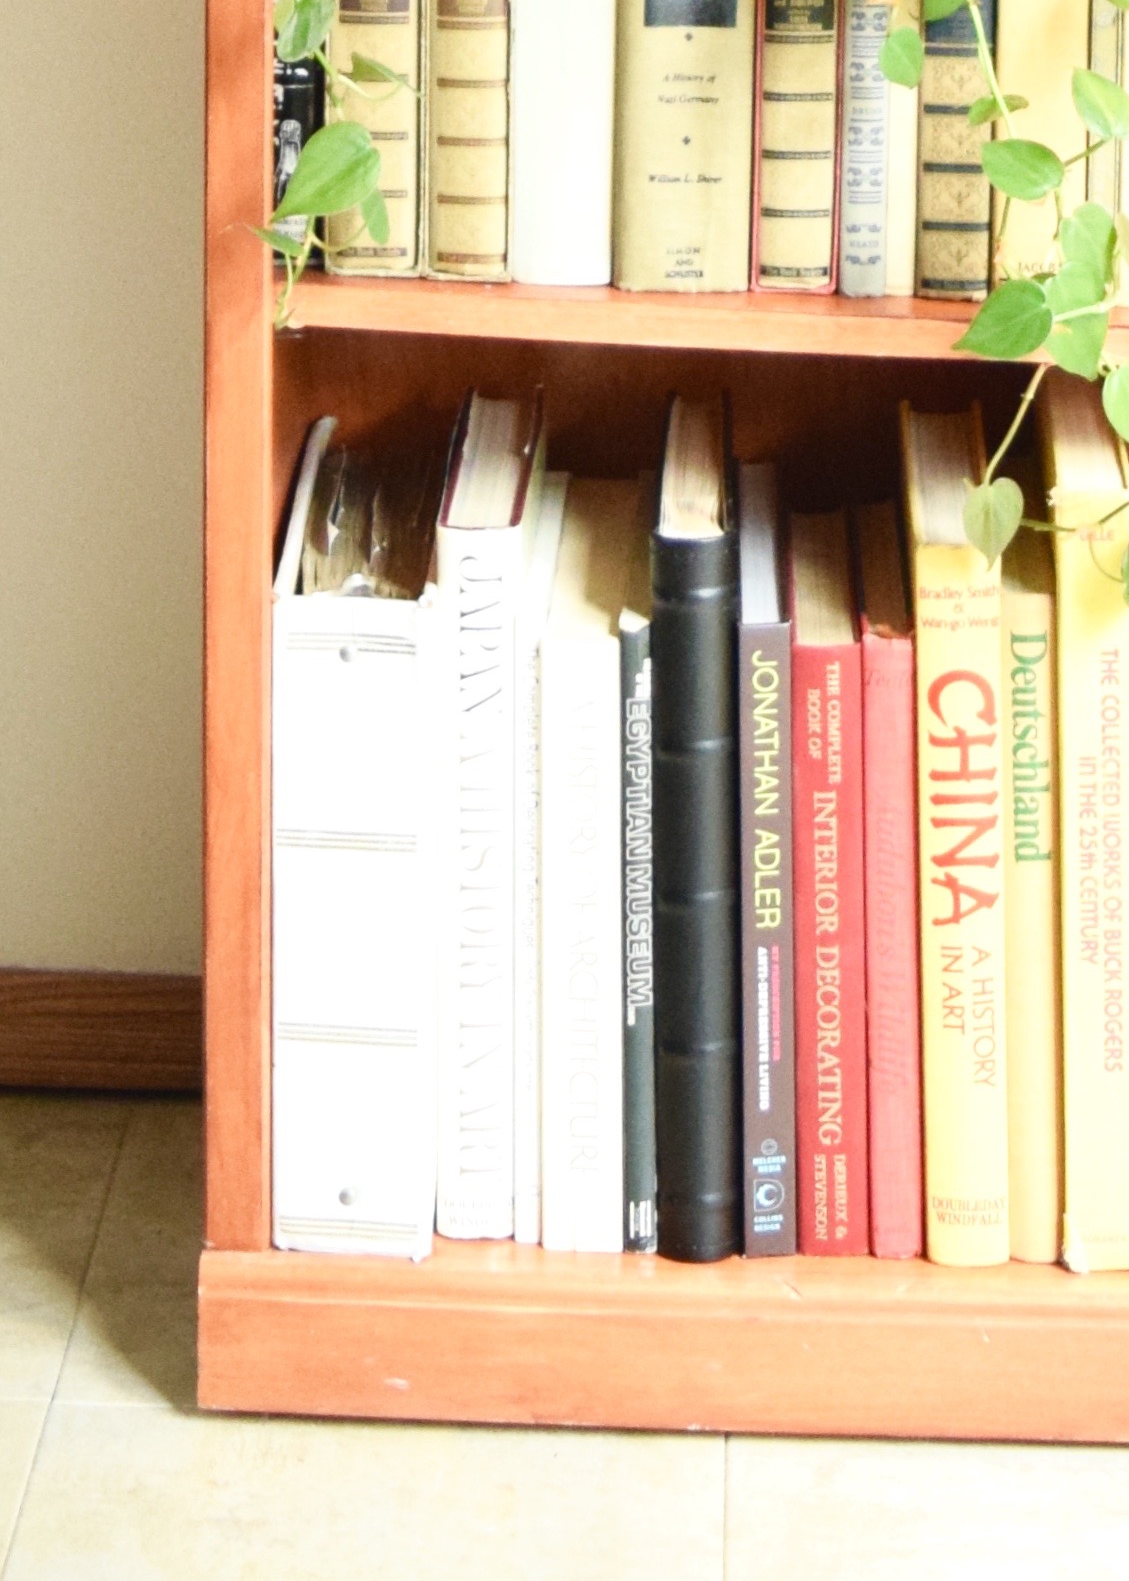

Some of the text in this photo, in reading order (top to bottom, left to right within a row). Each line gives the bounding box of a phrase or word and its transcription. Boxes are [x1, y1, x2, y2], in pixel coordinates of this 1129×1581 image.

[675, 258, 694, 267] AND
[458, 555, 503, 715] JAPAN
[918, 585, 1001, 601] Bradley Smith
[626, 697, 652, 858] EGYPTIAN
[751, 649, 781, 929] JONATHAN ADLER
[806, 688, 823, 760] BOOK OF
[826, 661, 842, 785] THE COMPLETE
[1009, 630, 1052, 865] Deutschland
[926, 669, 1001, 928] CHINA
[1079, 781, 1098, 871] THE 25th
[1100, 648, 1124, 1074] THE COLLECTED WORKS OF BUCK ROGERS
[458, 785, 503, 990] HISTORY
[626, 862, 654, 1008] MUSEUM
[757, 945, 771, 1112] ANTI-DEPRESSIVE LIVING
[812, 790, 843, 1146] INTERIOR DECORATING
[940, 945, 966, 1037] IN ART
[971, 946, 996, 1088] A HISTORY
[458, 1090, 503, 1178] ART
[813, 1153, 829, 1241] STEVENSON
[833, 1153, 848, 1240] DERIEUX &
[931, 1196, 1006, 1213] DOUBLEDAY
[936, 1211, 1003, 1226] WINDFALL
